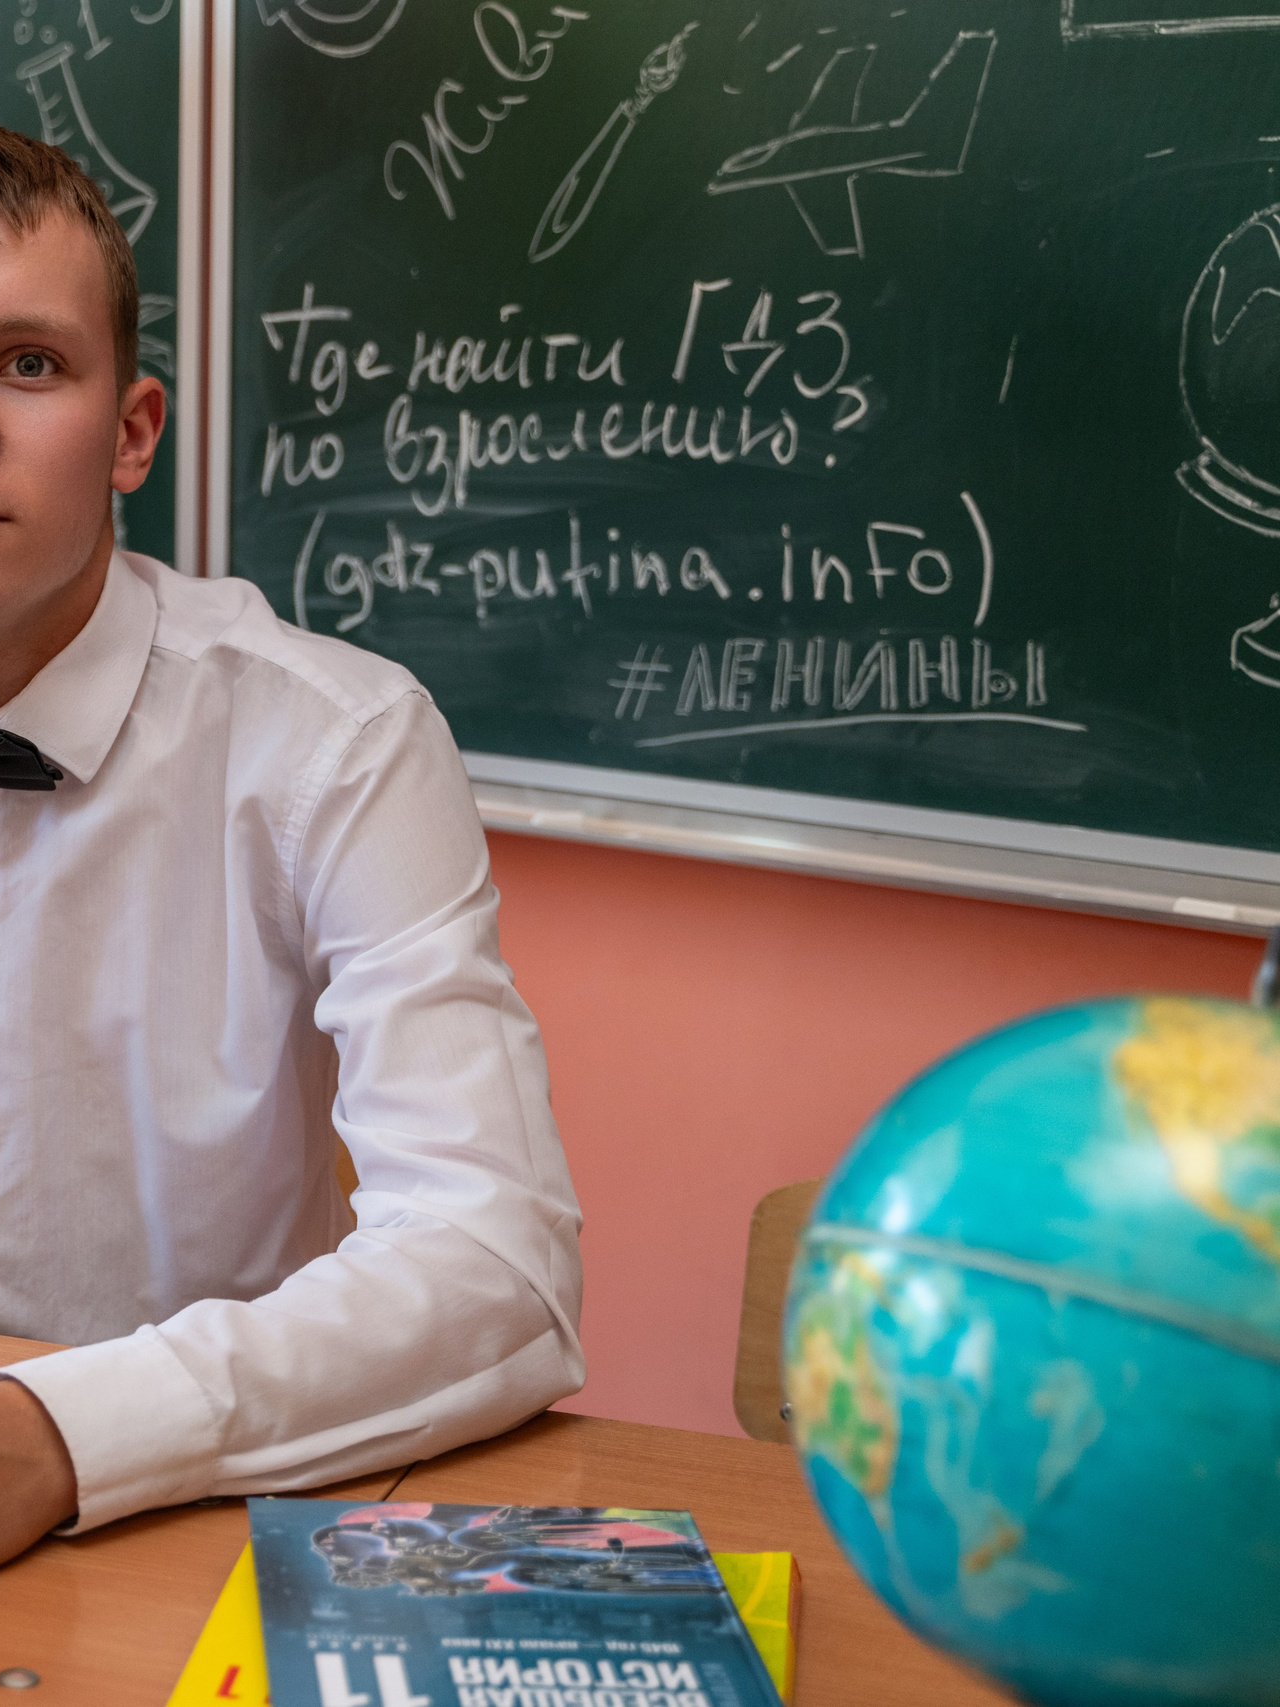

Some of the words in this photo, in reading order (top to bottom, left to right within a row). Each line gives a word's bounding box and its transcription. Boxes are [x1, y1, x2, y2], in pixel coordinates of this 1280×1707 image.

[261, 282, 394, 416] Где
[406, 304, 626, 393] найти
[672, 278, 851, 399] ГДЗ
[261, 422, 345, 497] по
[607, 636, 1047, 721] #ЛЕНИНЫ
[313, 1652, 430, 1707] 11
[447, 1655, 702, 1691] ИСТОРИЯ
